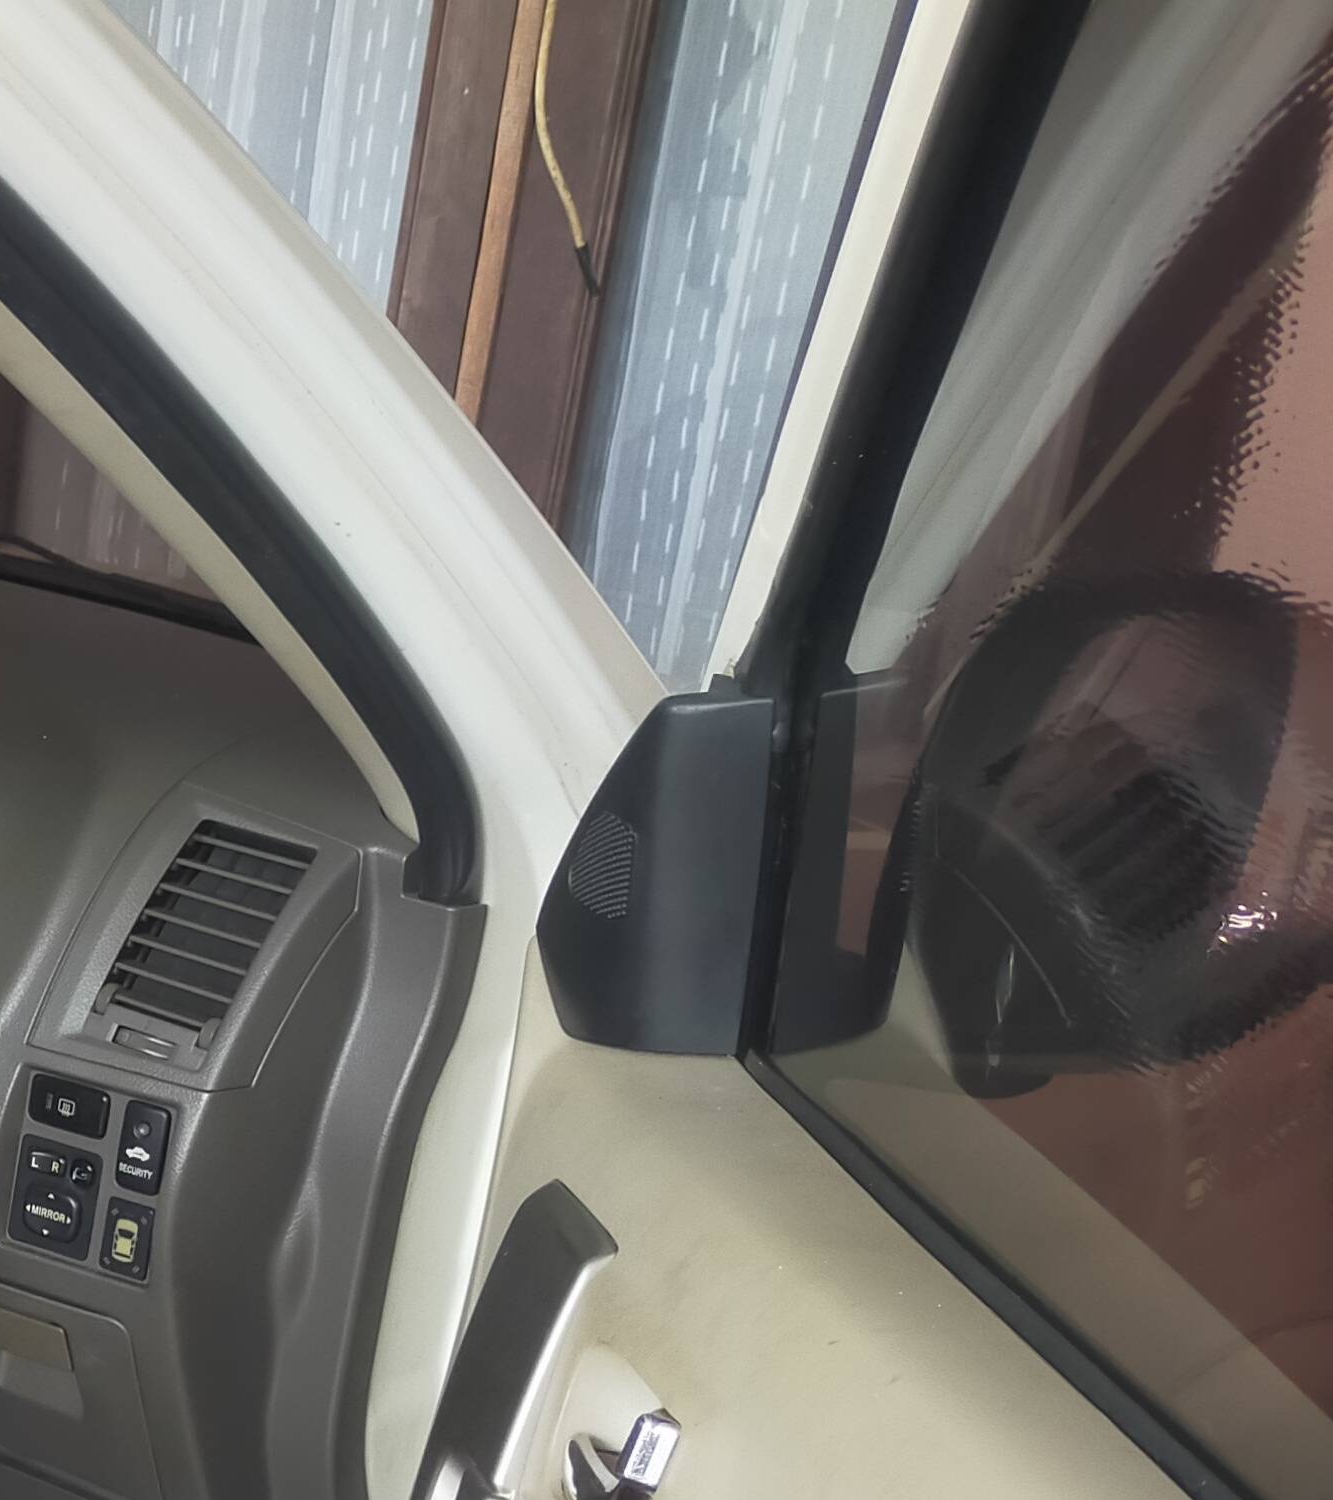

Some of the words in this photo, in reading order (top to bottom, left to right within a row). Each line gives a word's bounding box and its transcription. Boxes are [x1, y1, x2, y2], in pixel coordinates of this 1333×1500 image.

[31, 1156, 39, 1168] L
[51, 1161, 60, 1174] R
[118, 1162, 153, 1180] SECURITY
[31, 1204, 66, 1223] MIRROR
